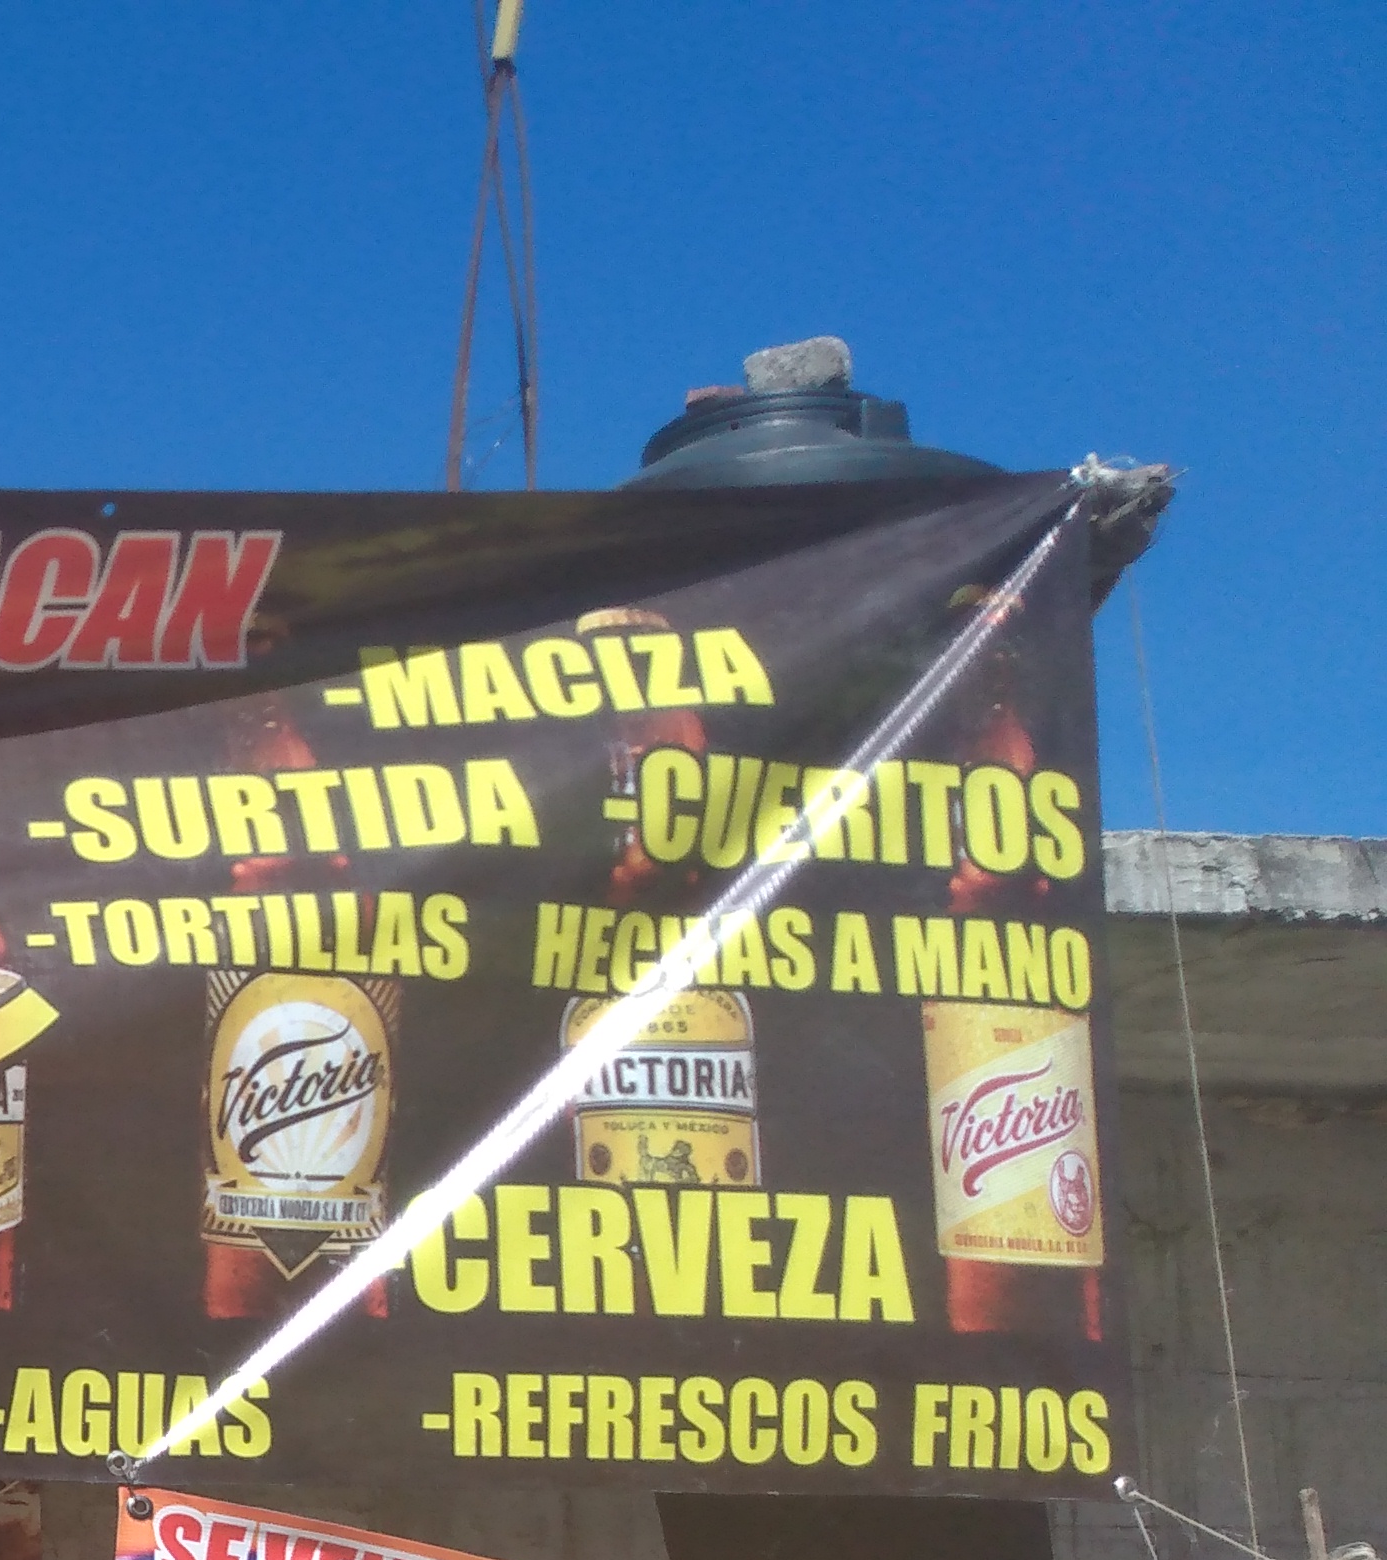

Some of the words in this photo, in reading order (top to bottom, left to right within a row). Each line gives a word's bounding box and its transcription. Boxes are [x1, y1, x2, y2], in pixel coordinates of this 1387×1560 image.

[323, 627, 776, 730] -MACIZA
[28, 759, 540, 864] -SURTIDA
[601, 747, 1087, 881] -CUERITOS
[26, 892, 469, 981] -TORTILLAS
[831, 910, 883, 994] A
[892, 915, 1091, 1010] MANO
[639, 1020, 688, 1034] 865
[216, 1021, 383, 1163] Victoria
[940, 1057, 1085, 1198] Victoria
[387, 1184, 915, 1323] CERVEZA
[421, 1372, 878, 1466] -REFRESCOS
[911, 1382, 1112, 1476] FRIOS
